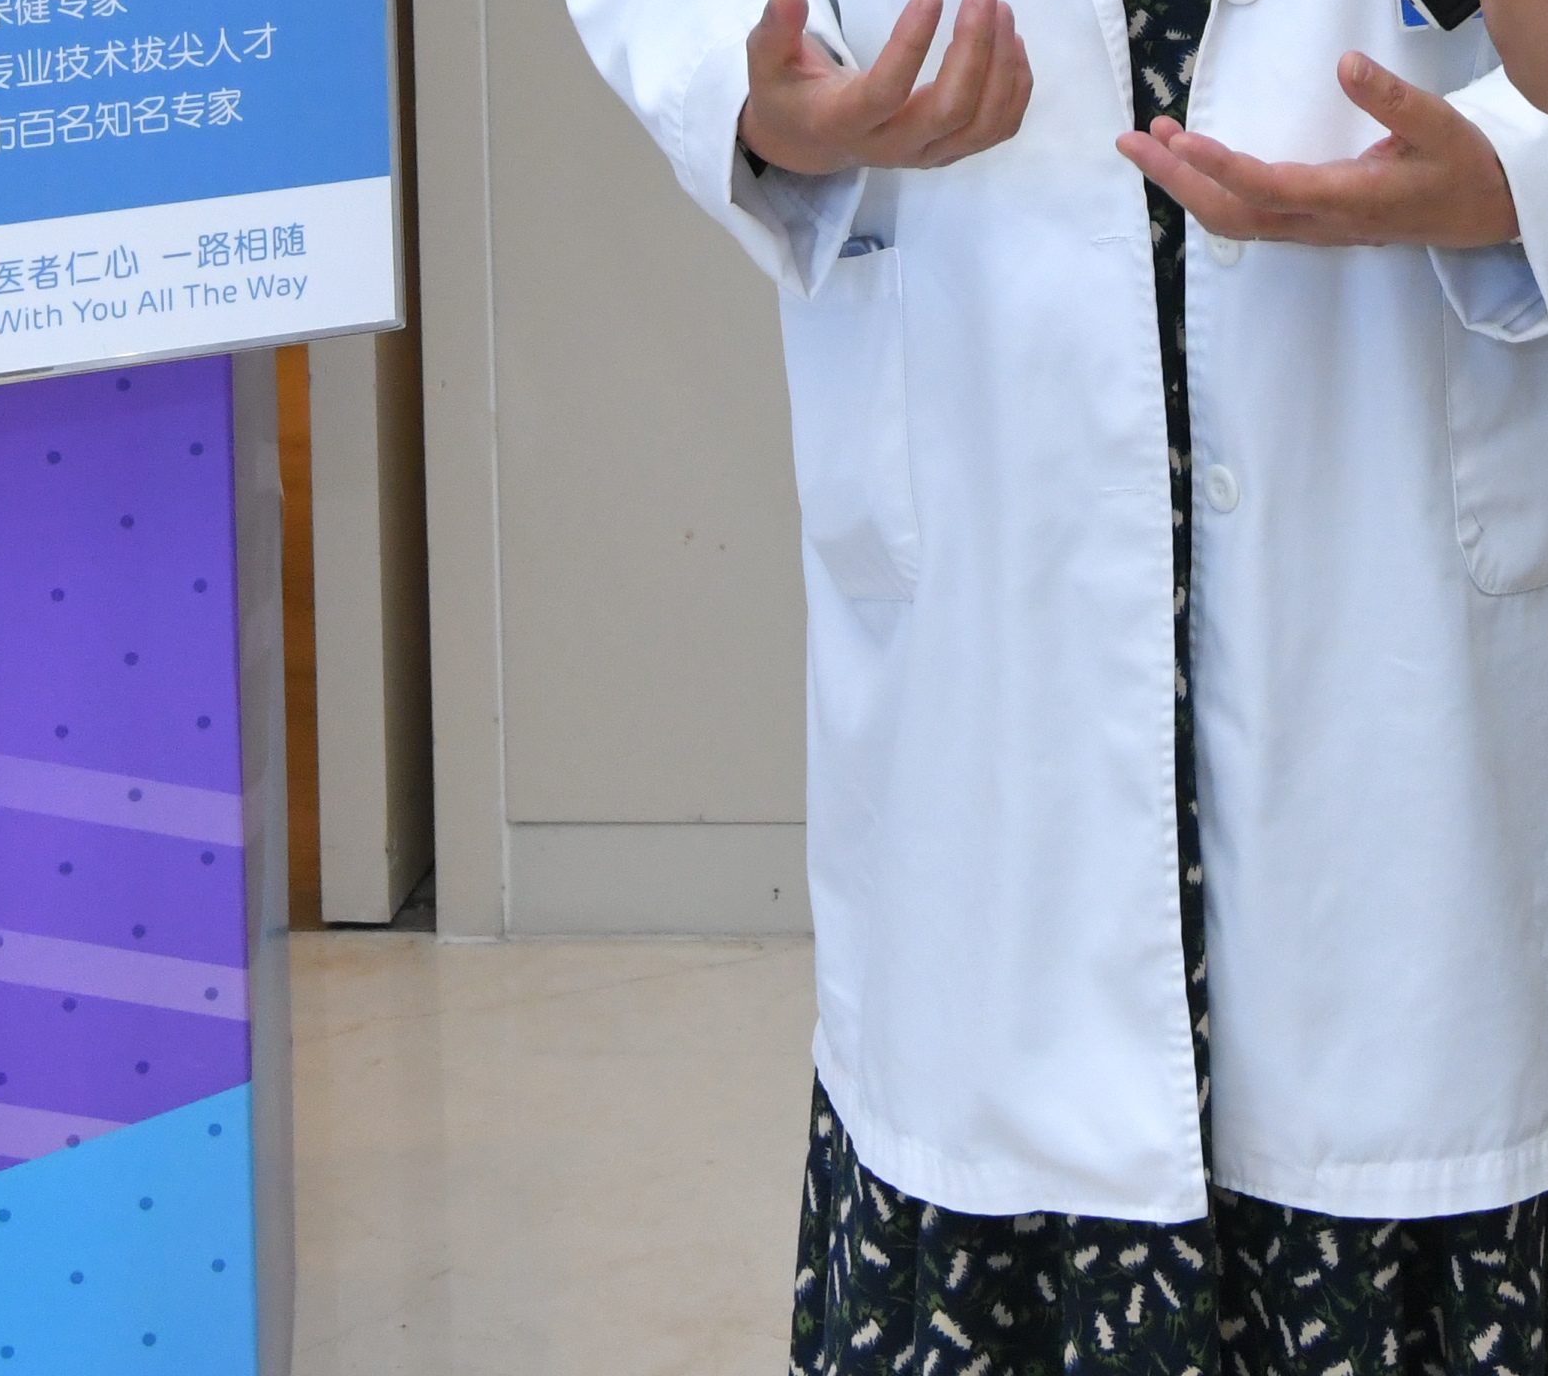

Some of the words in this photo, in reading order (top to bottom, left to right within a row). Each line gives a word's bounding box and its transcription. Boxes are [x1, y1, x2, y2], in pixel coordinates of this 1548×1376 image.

[162, 222, 308, 269] 一路相随
[72, 296, 127, 324] You
[137, 287, 174, 315] All
[182, 280, 239, 310] The
[247, 273, 309, 301] Way
